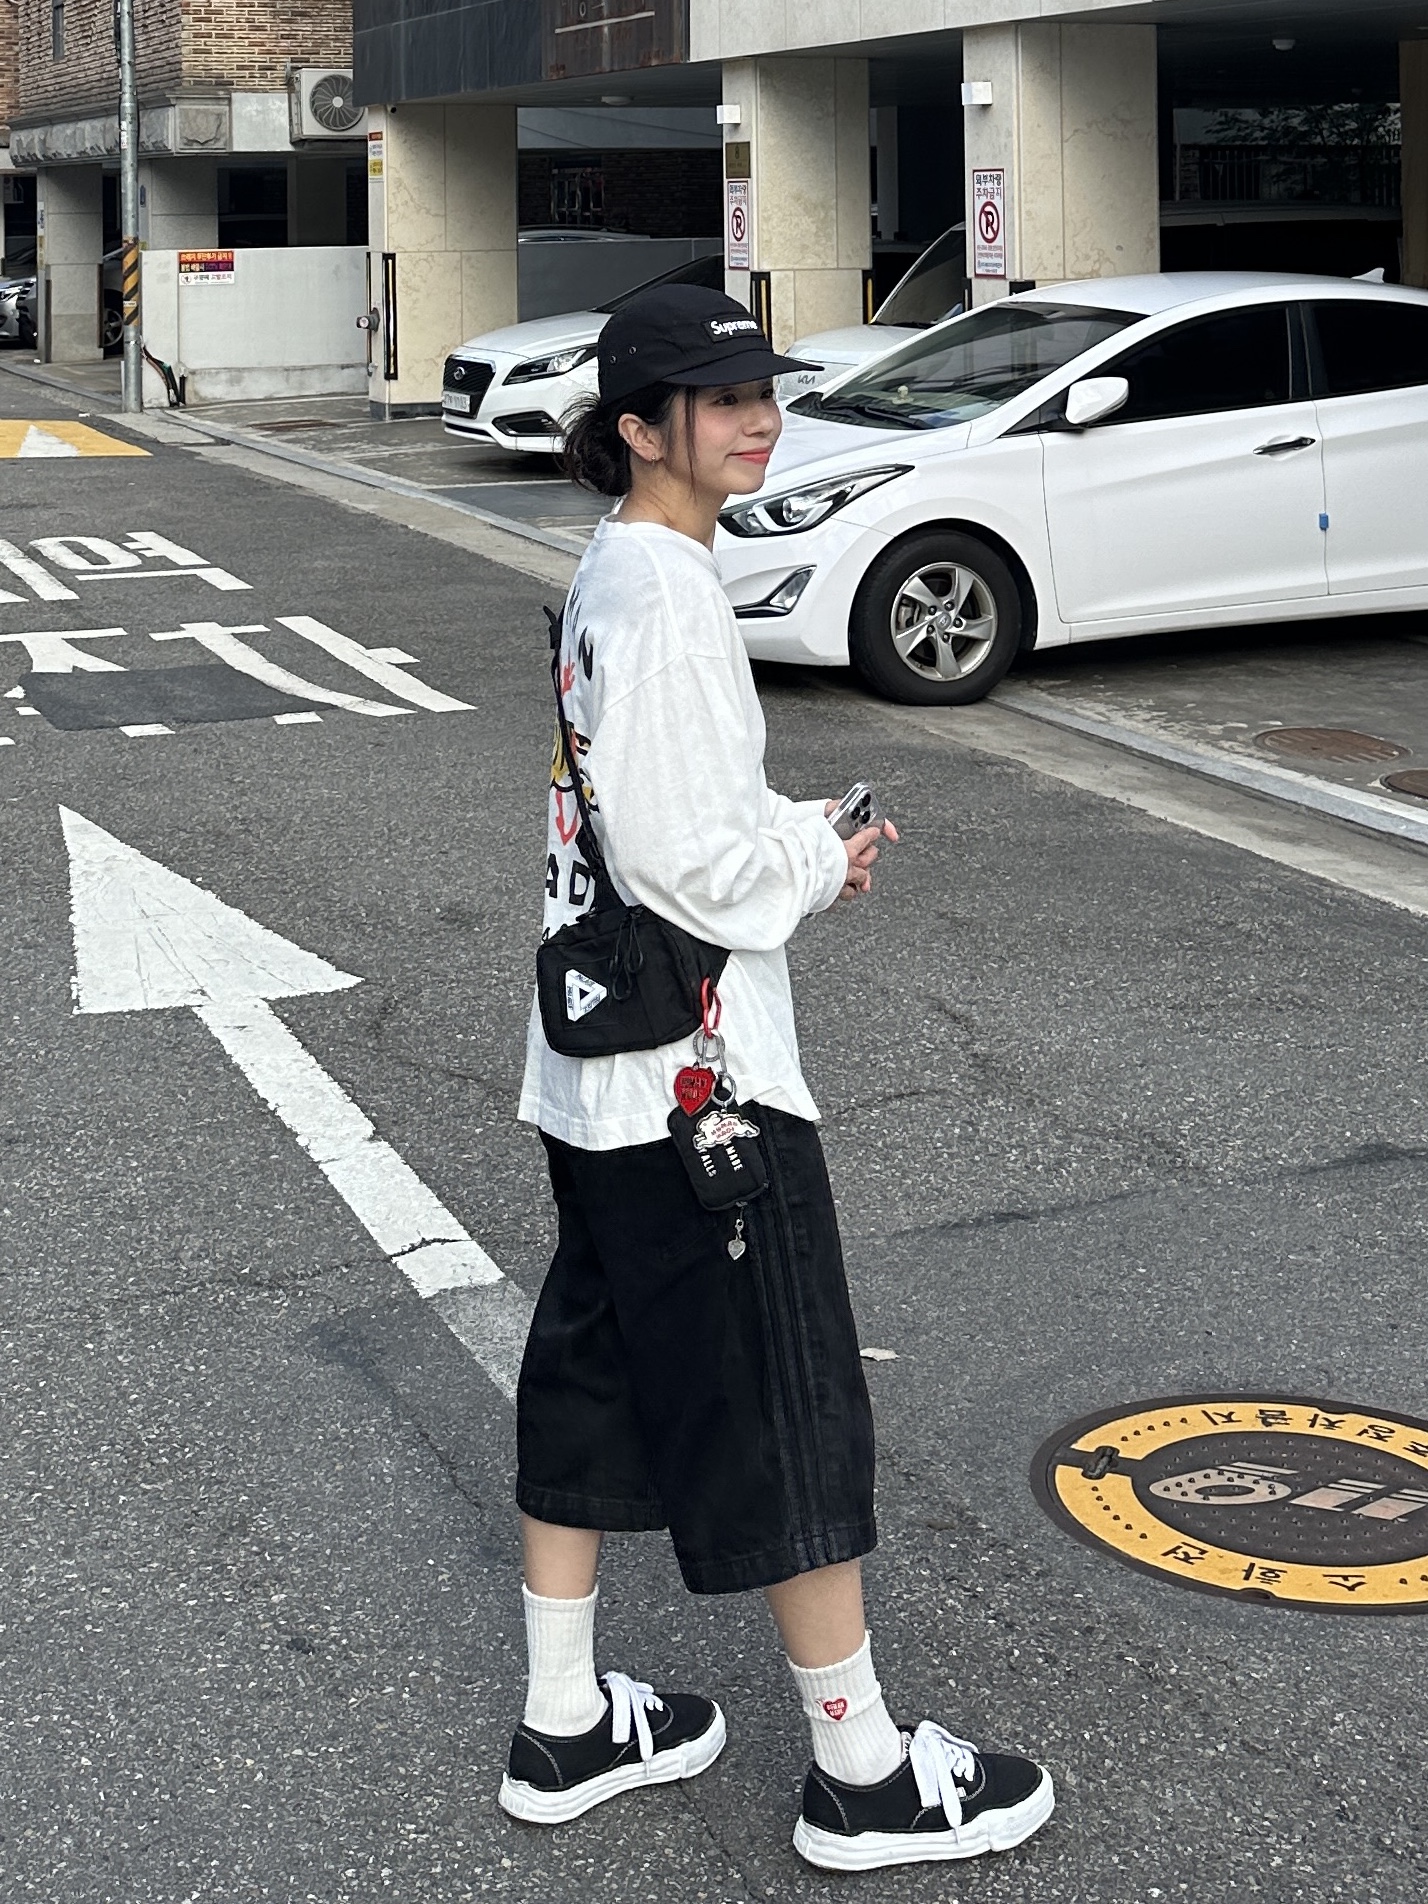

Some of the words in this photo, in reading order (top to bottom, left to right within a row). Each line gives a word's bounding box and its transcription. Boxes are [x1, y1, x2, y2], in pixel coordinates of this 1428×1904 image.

[975, 173, 1002, 186] 외부차량
[976, 187, 1002, 200] 주차금지
[710, 320, 758, 336] Supreme
[1160, 1540, 1368, 1592] 소화전
